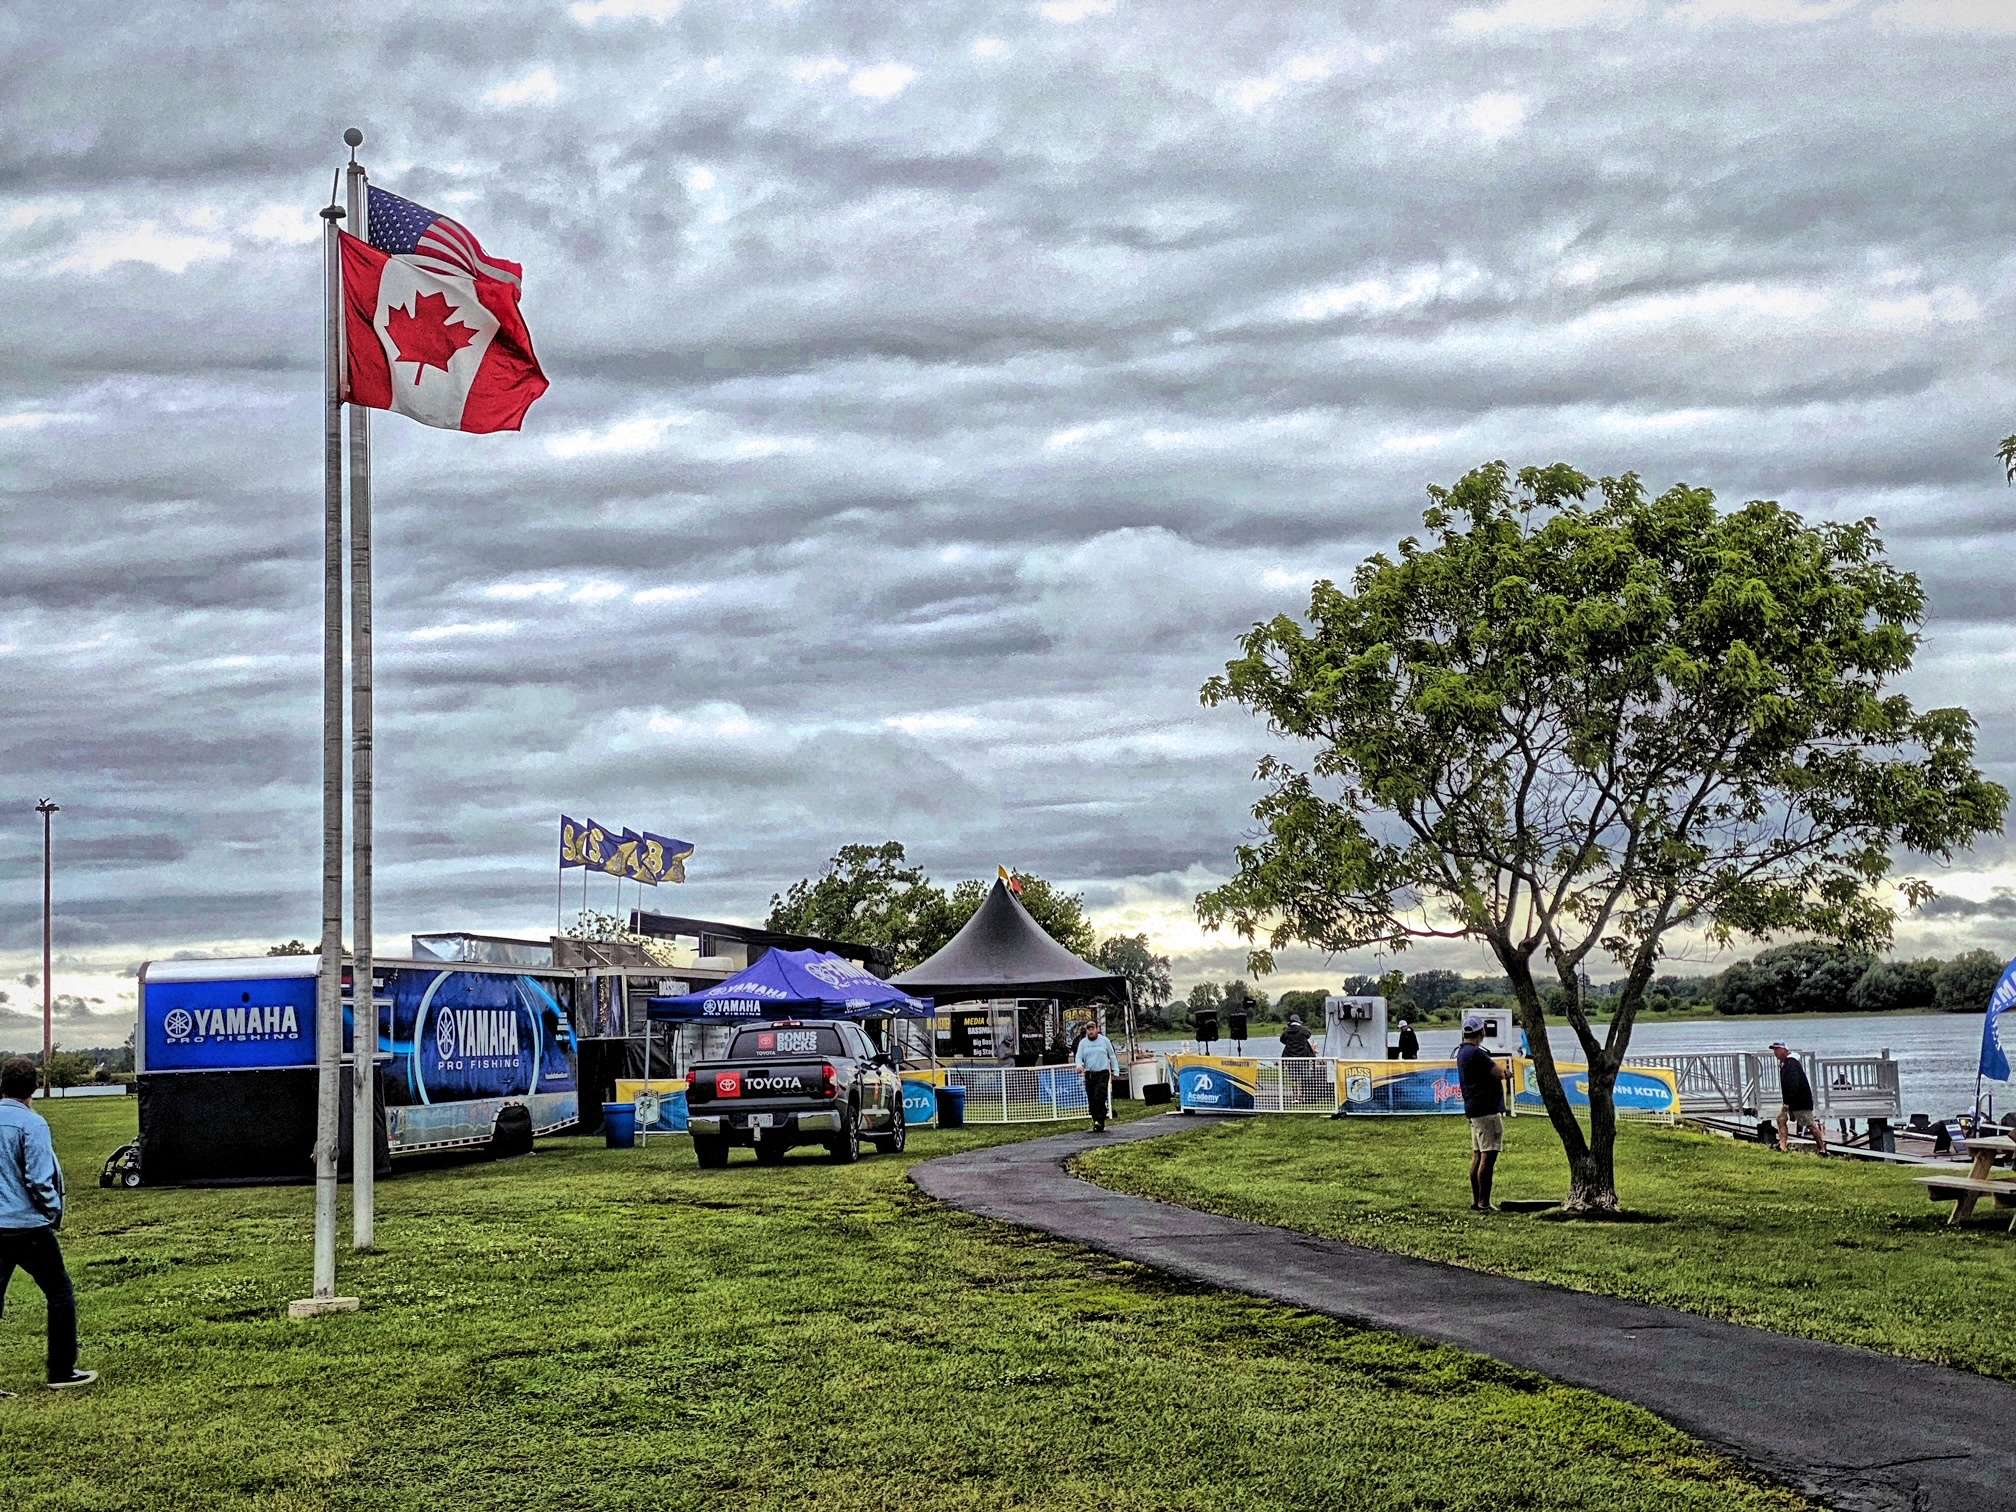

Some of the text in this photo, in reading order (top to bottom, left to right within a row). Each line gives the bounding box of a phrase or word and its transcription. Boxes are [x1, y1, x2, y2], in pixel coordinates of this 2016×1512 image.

[727, 982, 787, 999] YAMAHA
[717, 1000, 761, 1012] YAMAHA
[194, 1006, 298, 1035] YAMAHA
[964, 1018, 985, 1026] MEDIA
[217, 1033, 299, 1042] FISHING
[456, 1010, 519, 1057] YAMAHA
[777, 1031, 817, 1041] BONUS
[777, 1040, 817, 1052] BUCKS
[438, 1059, 520, 1070] PRO FISHING
[1346, 1067, 1371, 1077] BASS
[745, 1077, 801, 1090] TOYOTA
[1188, 1092, 1219, 1104] Academy
[1613, 1086, 1669, 1099] NN KOTA
[903, 1097, 930, 1109] OTA
